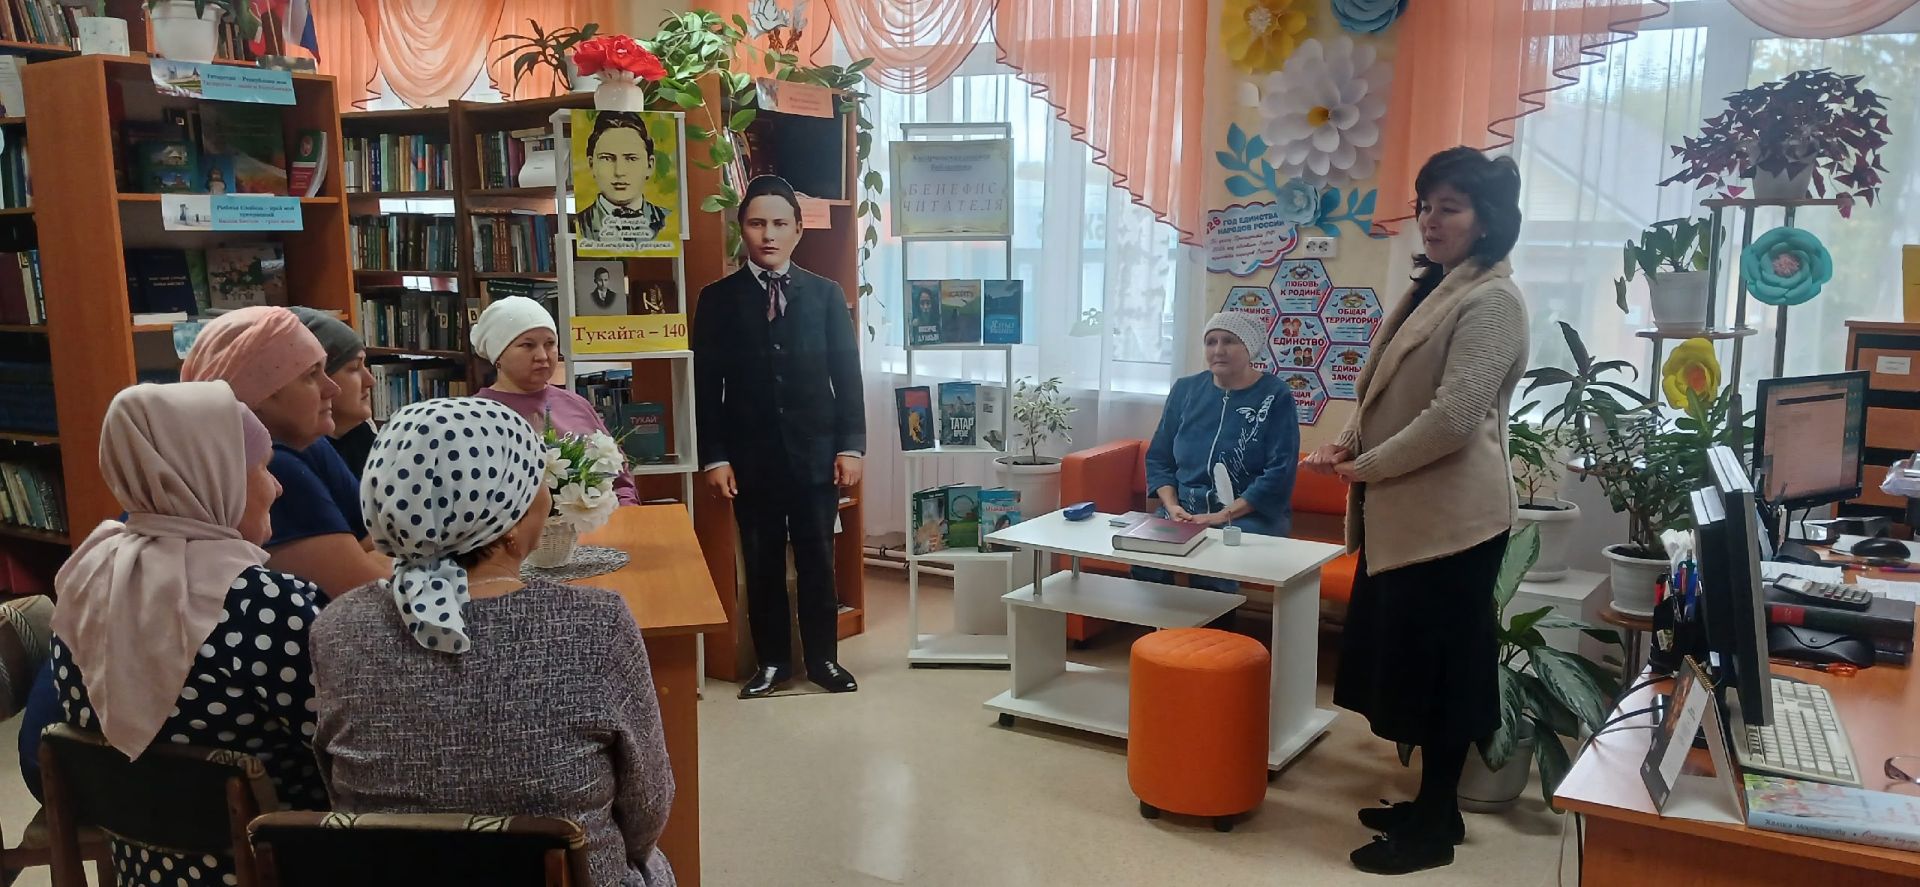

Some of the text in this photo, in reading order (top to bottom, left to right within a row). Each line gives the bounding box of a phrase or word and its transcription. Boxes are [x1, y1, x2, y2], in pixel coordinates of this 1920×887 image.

[908, 182, 997, 196] БЕНЕФИС
[903, 198, 1003, 212] ЧИТАТЕЛЯ
[1206, 212, 1278, 234] 26 ГОД ЕДИНСТВА
[1218, 224, 1252, 234] НАРОДОВ
[572, 325, 645, 345] Тукайга
[663, 323, 686, 338] 140
[1273, 337, 1325, 346] ЕДИНСТВО
[1331, 365, 1361, 373] ЕДИНЫ
[950, 417, 975, 430] ТАТАР
